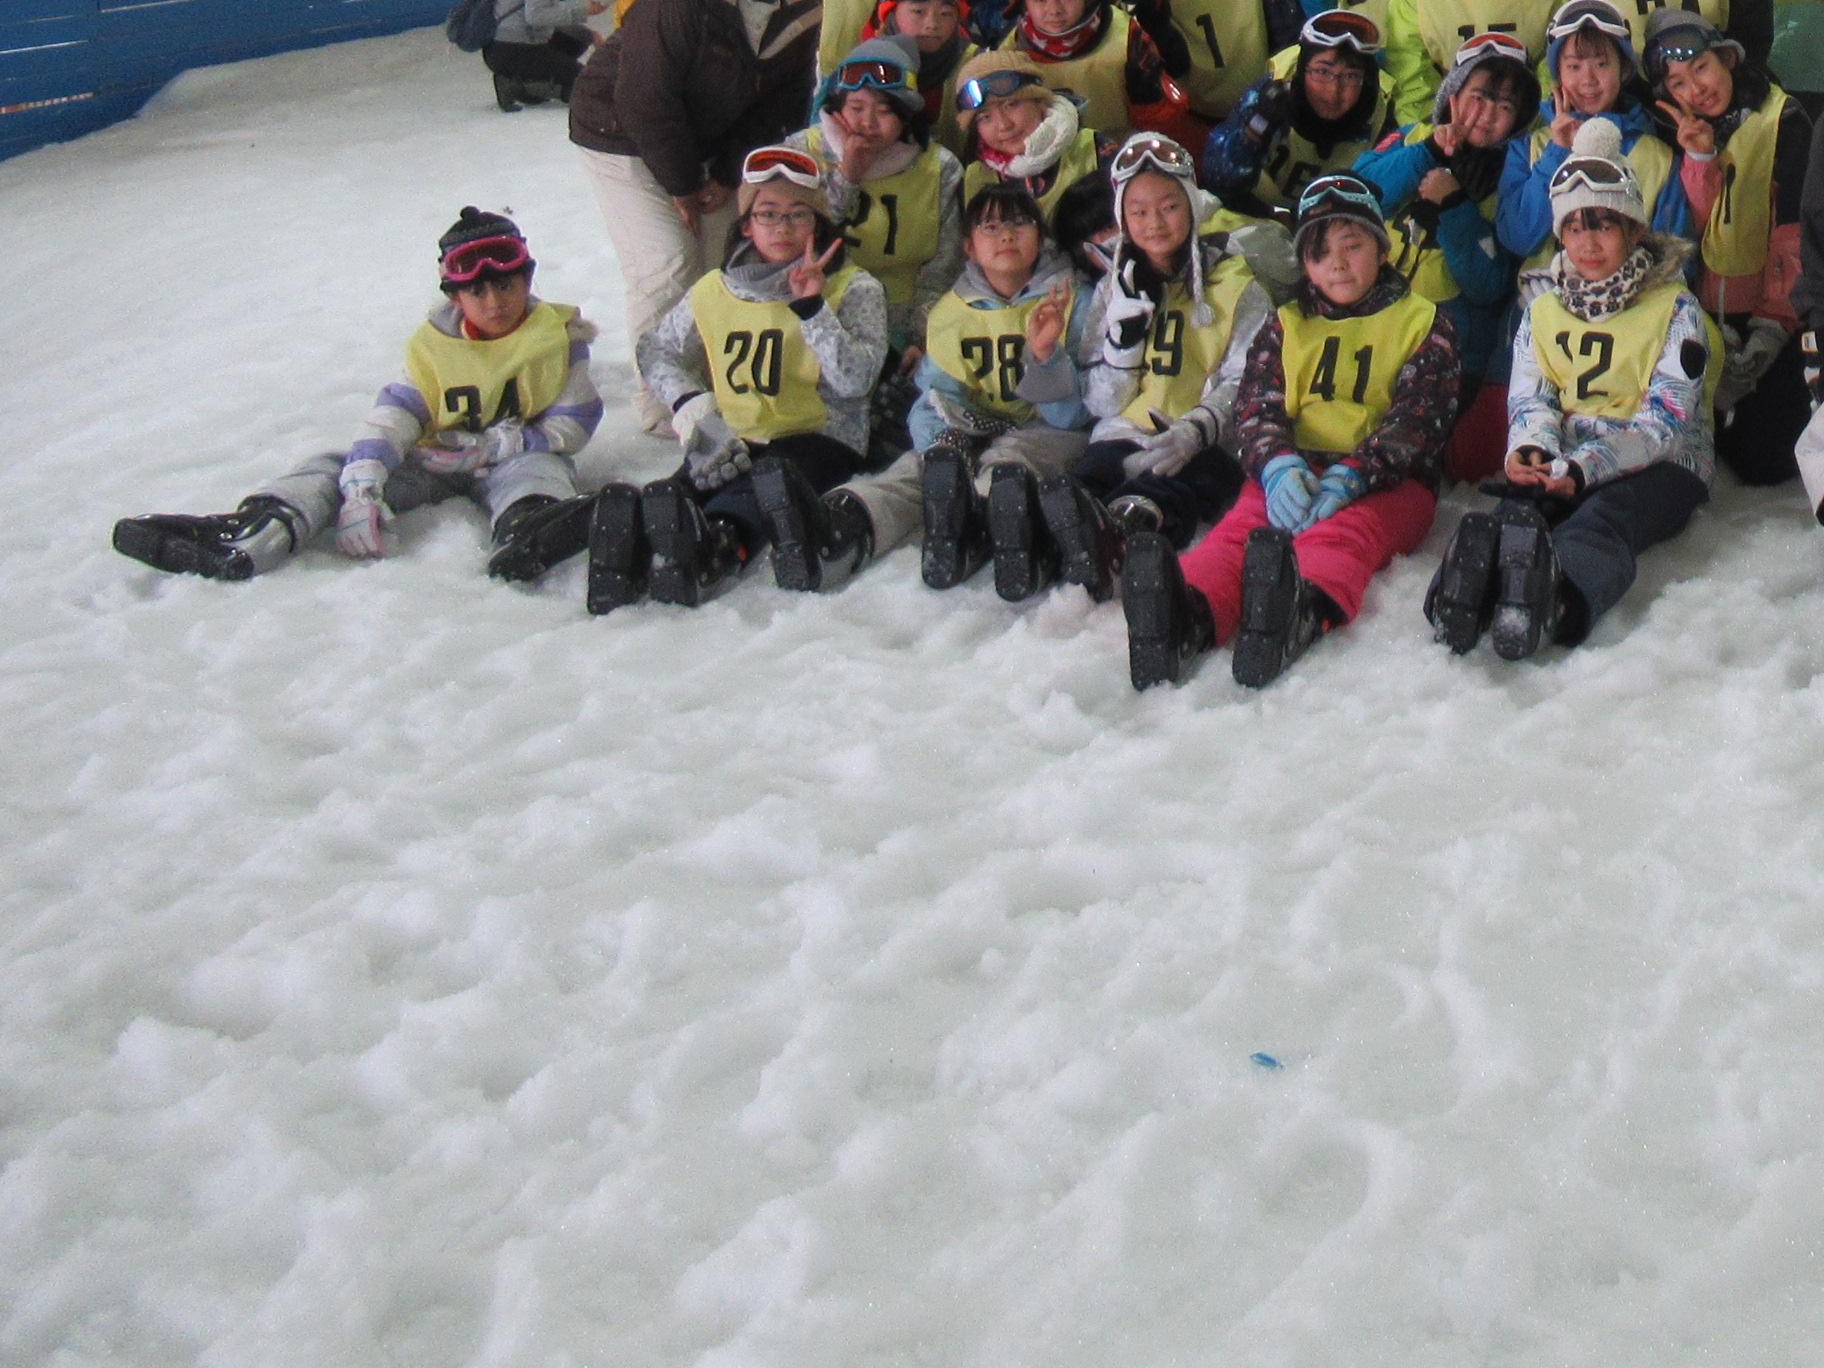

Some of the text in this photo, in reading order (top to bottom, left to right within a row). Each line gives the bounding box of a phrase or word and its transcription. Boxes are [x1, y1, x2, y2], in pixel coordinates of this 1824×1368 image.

[1196, 13, 1225, 69] 1
[724, 329, 784, 397] 20
[961, 334, 1026, 402] 28
[1309, 336, 1373, 404] 41
